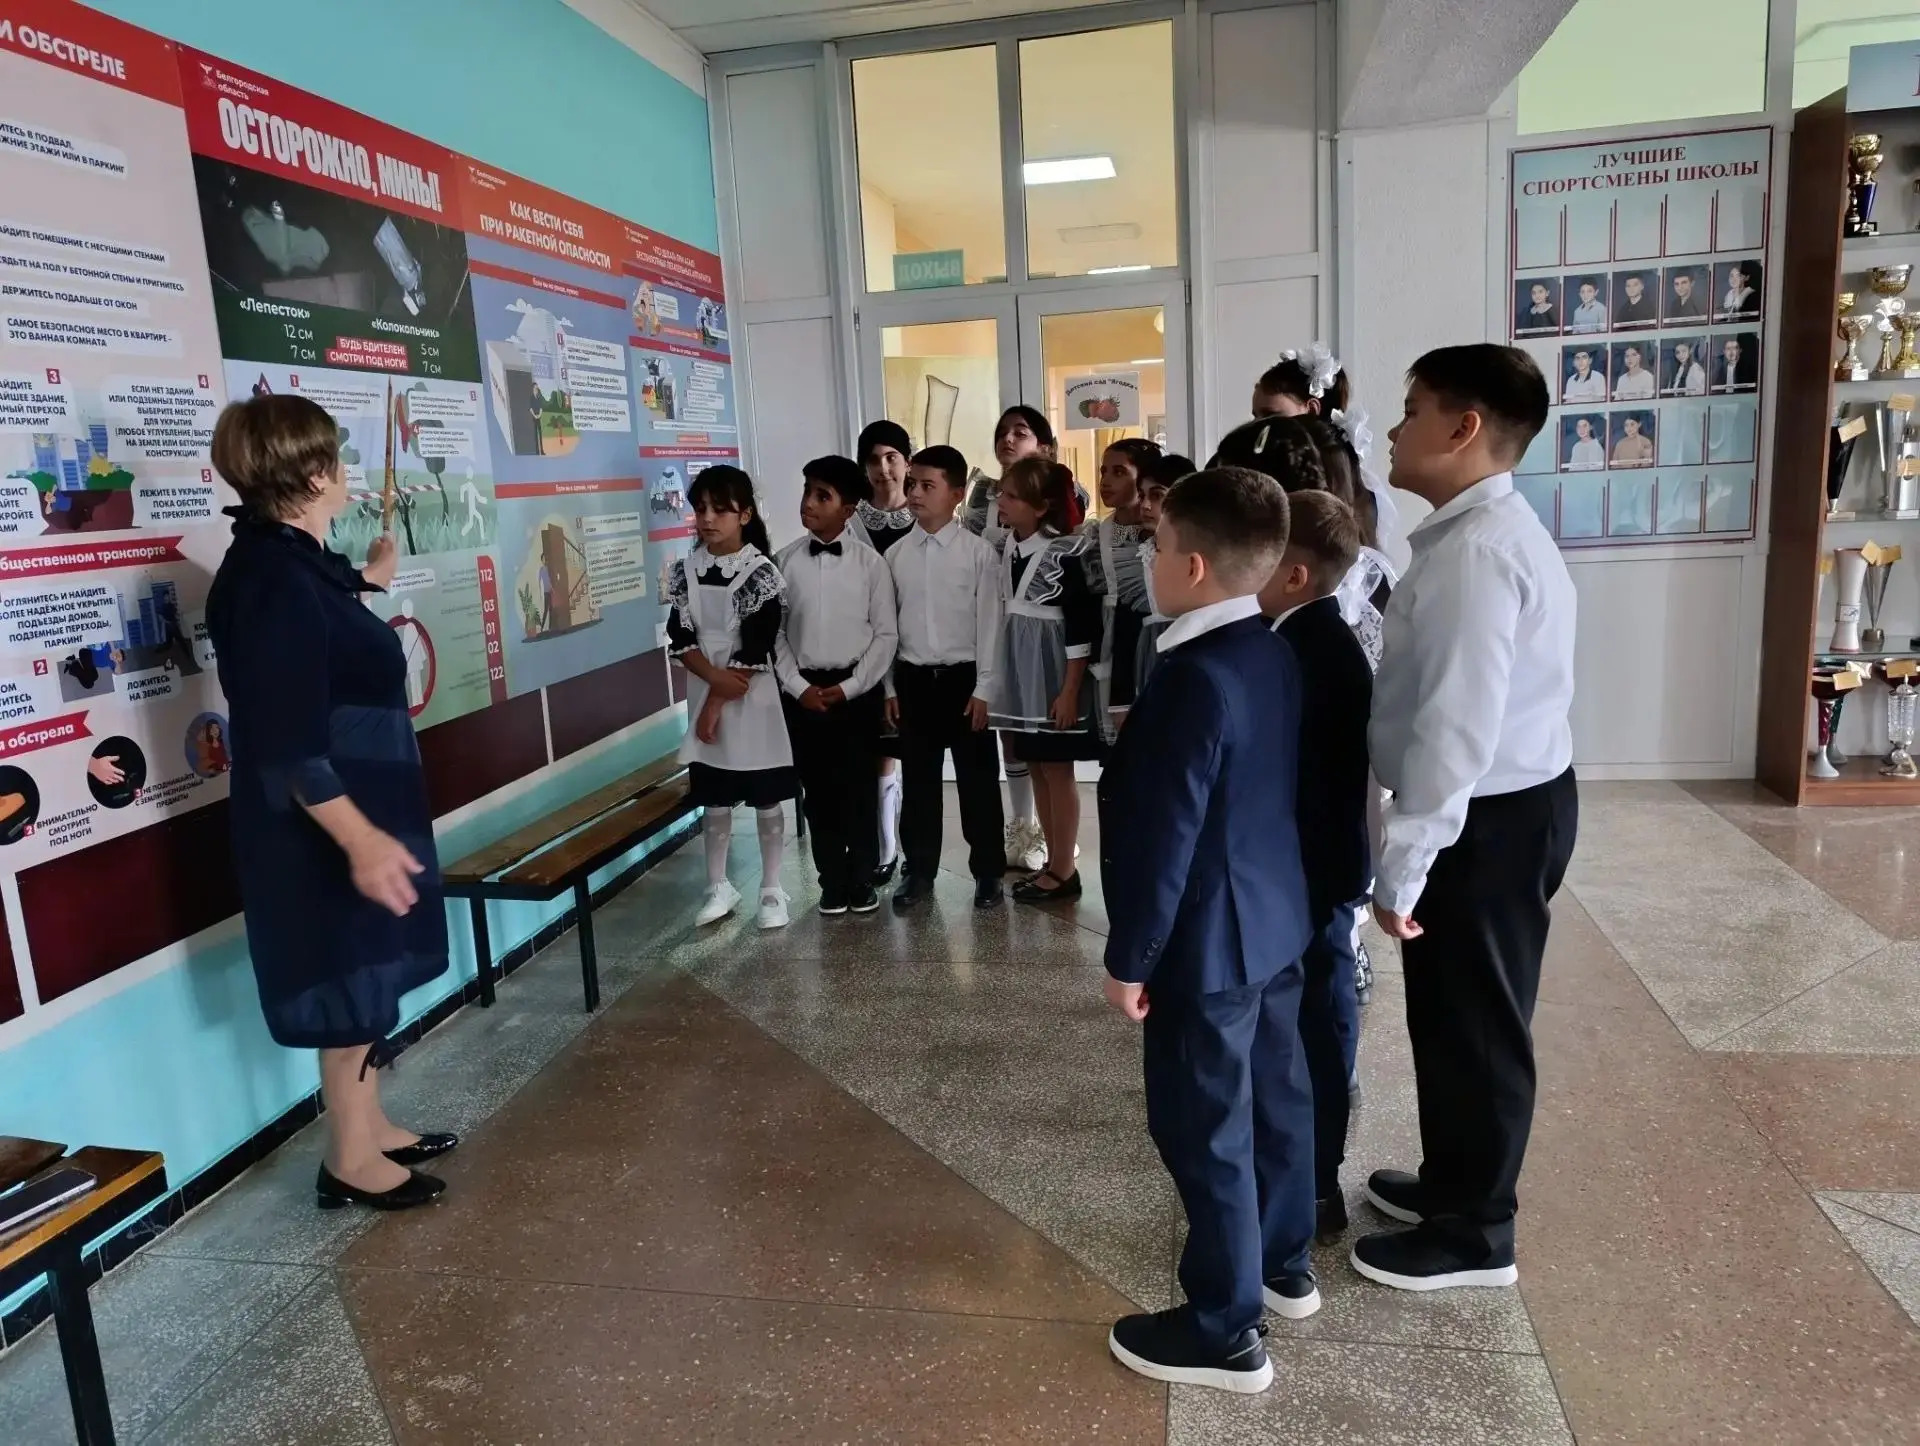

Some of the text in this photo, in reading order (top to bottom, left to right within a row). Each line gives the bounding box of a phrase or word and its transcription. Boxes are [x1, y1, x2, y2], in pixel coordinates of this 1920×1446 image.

[18, 25, 127, 81] ОБСТРЕЛЕ
[215, 69, 270, 97] Белгородская
[217, 82, 250, 101] область
[27, 130, 34, 139] В
[35, 132, 75, 150] ПОДВАЛ,
[29, 142, 61, 157] ЭТАЖИ
[62, 151, 81, 162] ИЛИ
[82, 156, 88, 164] В
[88, 158, 125, 174] ПАРКИНГ
[218, 97, 443, 213] ОСТОРОЖНО, МИНЫ!
[1594, 146, 1687, 169] ЛУЧШИЕ
[1523, 160, 1759, 196] СПОРТСМЕНЫ ШКОЛЫ
[509, 200, 585, 240] КАК ВЕСТИ СЕБЯ
[32, 232, 84, 248] ПОМЕЩЕНИЕ
[84, 239, 90, 249] С
[90, 242, 133, 257] НЕСУЩИМИ
[133, 250, 165, 263] СТЕНАМИ
[479, 214, 502, 235] ПРИ
[505, 221, 558, 252] РАКЕТНОЙ
[558, 239, 611, 270] ОПАСНОСТИ
[29, 257, 42, 269] НА
[42, 262, 61, 273] ПОЛ
[62, 265, 68, 273] У
[69, 266, 111, 281] БЕТОННОЙ
[111, 273, 135, 284] СТЕНЫ
[136, 276, 142, 285] И
[142, 277, 185, 292] ПРИГНИТЕСЬ
[2, 285, 138, 310] ДЕРЖИТЕСЬ ПОДАЛЬШЕ ОТ ОКОН
[239, 298, 311, 319] «Лепесток»
[7, 318, 39, 329] САМОЕ
[40, 321, 96, 335] БЕЗОПАСНОЕ
[97, 327, 122, 337] МЕСТО
[123, 329, 129, 338] В
[284, 324, 297, 339] 12
[371, 318, 440, 338] «Колокольчик»
[9, 330, 107, 347] ЭТО ВАННАЯ КОМНАТА
[340, 338, 407, 355] БУДЬ БДИТЕЛЕН!
[290, 345, 298, 358] 7
[420, 343, 427, 356] 5
[330, 351, 408, 369] СМОТРИ ПОД НОГИ!
[422, 361, 429, 373] 7
[50, 370, 58, 383] 3
[200, 376, 207, 387] 4
[131, 385, 194, 396] ЕСЛИ НЕТ ЗДАНИЙ
[31, 393, 68, 405] ЗДАНИЕ,
[108, 395, 126, 403] ИЛИ
[127, 395, 174, 406] ПОДЗЕМНЫХ
[26, 405, 67, 416] ПЕРЕХОД
[137, 407, 197, 416] ВЫБЕРИТЕ МЕСТО
[8, 416, 50, 426] ПАРКИНГ
[143, 417, 193, 427] ДЛЯ УКРЫТИЯ
[126, 438, 213, 447] НА ЗЕМЛЕ ИЛИ БЕТОННЫ
[202, 470, 210, 481] 5
[140, 488, 171, 497] ЛЕЖИТЕ
[171, 488, 177, 496] В
[152, 497, 208, 508] ПОКА ОБСТРЕЛ
[151, 509, 211, 520] НЕ ПРЕКРАТИТСЯ
[98, 545, 166, 563] транспорте
[479, 568, 493, 582] 112
[4, 586, 107, 607] ОГЛЯНИТЕСЬ И НАЙДИТЕ
[26, 602, 76, 616] НАДЁЖНОЕ
[77, 597, 116, 611] УКРЫТИЕ:
[483, 600, 495, 613] 03
[17, 610, 102, 630] ПОДЪЕЗДЫ ДОМОВ,
[9, 620, 112, 643] ПОДЗЕМНЫЕ ПЕРЕХОДЫ,
[486, 622, 496, 635] 01
[44, 635, 84, 649] ПАРКИНГ
[488, 640, 500, 654] 02
[36, 661, 46, 675] 2
[165, 658, 172, 669] 4
[489, 665, 505, 681] 122
[127, 675, 171, 691] ЛОЖИТЕСЬ
[129, 686, 172, 702] НА ЗЕМЛЮ
[8, 723, 75, 749] обстрела
[135, 773, 195, 798] 3 НЕ ПОДНИМАЙТЕ
[140, 793, 162, 805] ЗЕМЛИ
[156, 793, 189, 809] ПРЕДМЕТЫ
[25, 804, 98, 836] 2 ВНИМАТЕЛЬНО
[48, 817, 91, 837] СМОТРИТЕ
[50, 827, 92, 848] ПОД НОГИ
